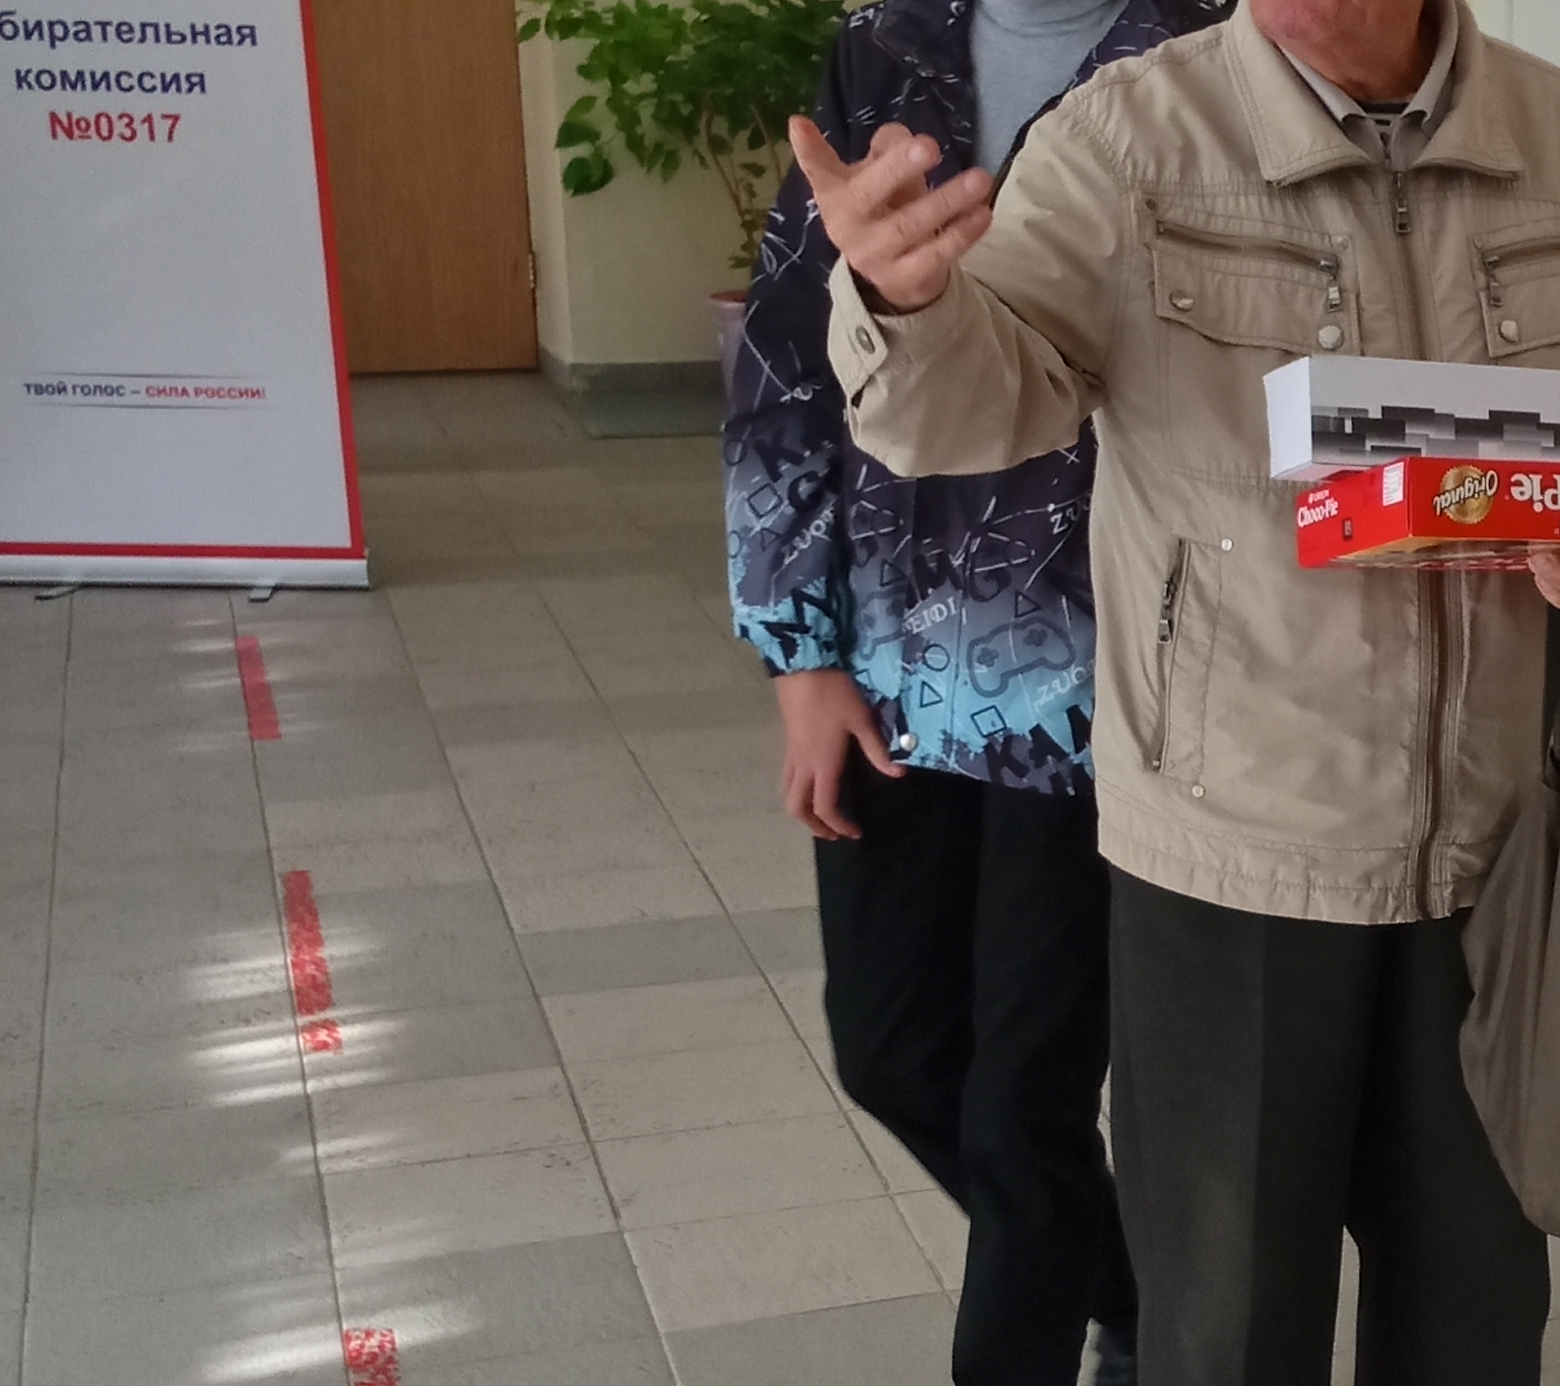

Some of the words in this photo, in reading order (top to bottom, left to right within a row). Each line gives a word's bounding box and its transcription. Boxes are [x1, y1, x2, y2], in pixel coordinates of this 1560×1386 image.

[0, 10, 258, 50] бирательная
[15, 65, 208, 95] комиссия
[48, 111, 181, 143] №0317
[23, 380, 68, 396] ТВОЙ
[72, 384, 126, 397] ГОЛОС
[145, 385, 190, 398] СИЛА
[195, 386, 266, 399] РОССИИ!
[1433, 469, 1499, 515] Original
